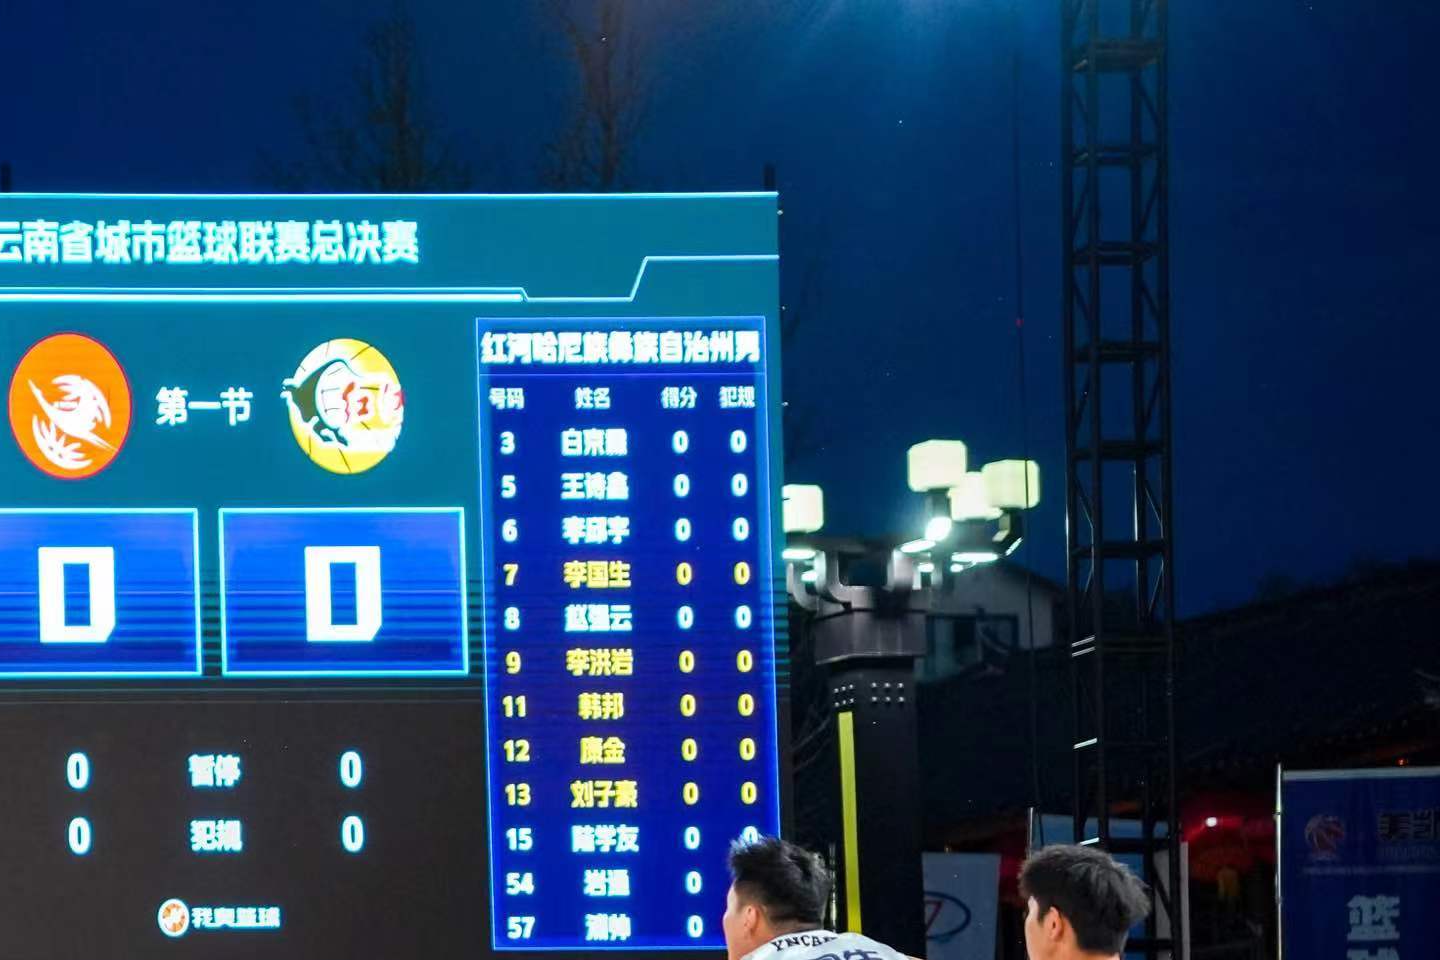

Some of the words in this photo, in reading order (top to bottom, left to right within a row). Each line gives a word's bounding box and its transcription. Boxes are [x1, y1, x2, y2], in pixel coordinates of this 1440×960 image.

[155, 386, 254, 425] 第一节
[490, 388, 524, 409] 号码
[576, 387, 610, 408] 姓名
[662, 387, 697, 408] 得分
[720, 386, 754, 407] 犯规
[501, 432, 515, 453] 3
[562, 428, 627, 456] 白京
[674, 431, 688, 452] 0
[731, 430, 746, 452] 0
[503, 475, 516, 497] 5
[675, 474, 689, 496] 0
[733, 474, 747, 496] 0
[503, 519, 517, 541] 6
[676, 519, 690, 540] 0
[734, 518, 749, 540] 0
[504, 564, 518, 585] 7
[564, 560, 631, 588] 李国生
[677, 563, 692, 585] 0
[735, 562, 750, 584] 0
[38, 547, 116, 643] 0
[304, 546, 383, 642] 0
[506, 607, 519, 629] 8
[679, 606, 693, 628] 0
[737, 606, 751, 628] 0
[506, 651, 521, 674] 9
[566, 648, 633, 676] 李洪岩
[679, 650, 694, 673] 0
[737, 650, 752, 672] 0
[503, 696, 526, 717] 11
[579, 692, 624, 719] 韩邦
[681, 694, 696, 716] 0
[738, 694, 754, 716] 0
[504, 740, 530, 761] 12
[682, 739, 697, 761] 0
[740, 738, 755, 760] 0
[67, 753, 88, 788] 0
[189, 755, 240, 786] 暂停
[341, 752, 361, 786] 0
[506, 783, 531, 805] 13
[570, 780, 637, 807] 刘子豪
[684, 783, 698, 804] 0
[742, 782, 757, 804] 0
[69, 818, 90, 853] 0
[191, 820, 242, 850] 犯规
[343, 816, 363, 851] 0
[508, 828, 532, 850] 15
[573, 824, 639, 852] 学友
[686, 827, 700, 849] 0
[510, 873, 534, 894] 54
[687, 871, 701, 893] 0
[511, 917, 535, 939] 57
[689, 915, 703, 937] 0
